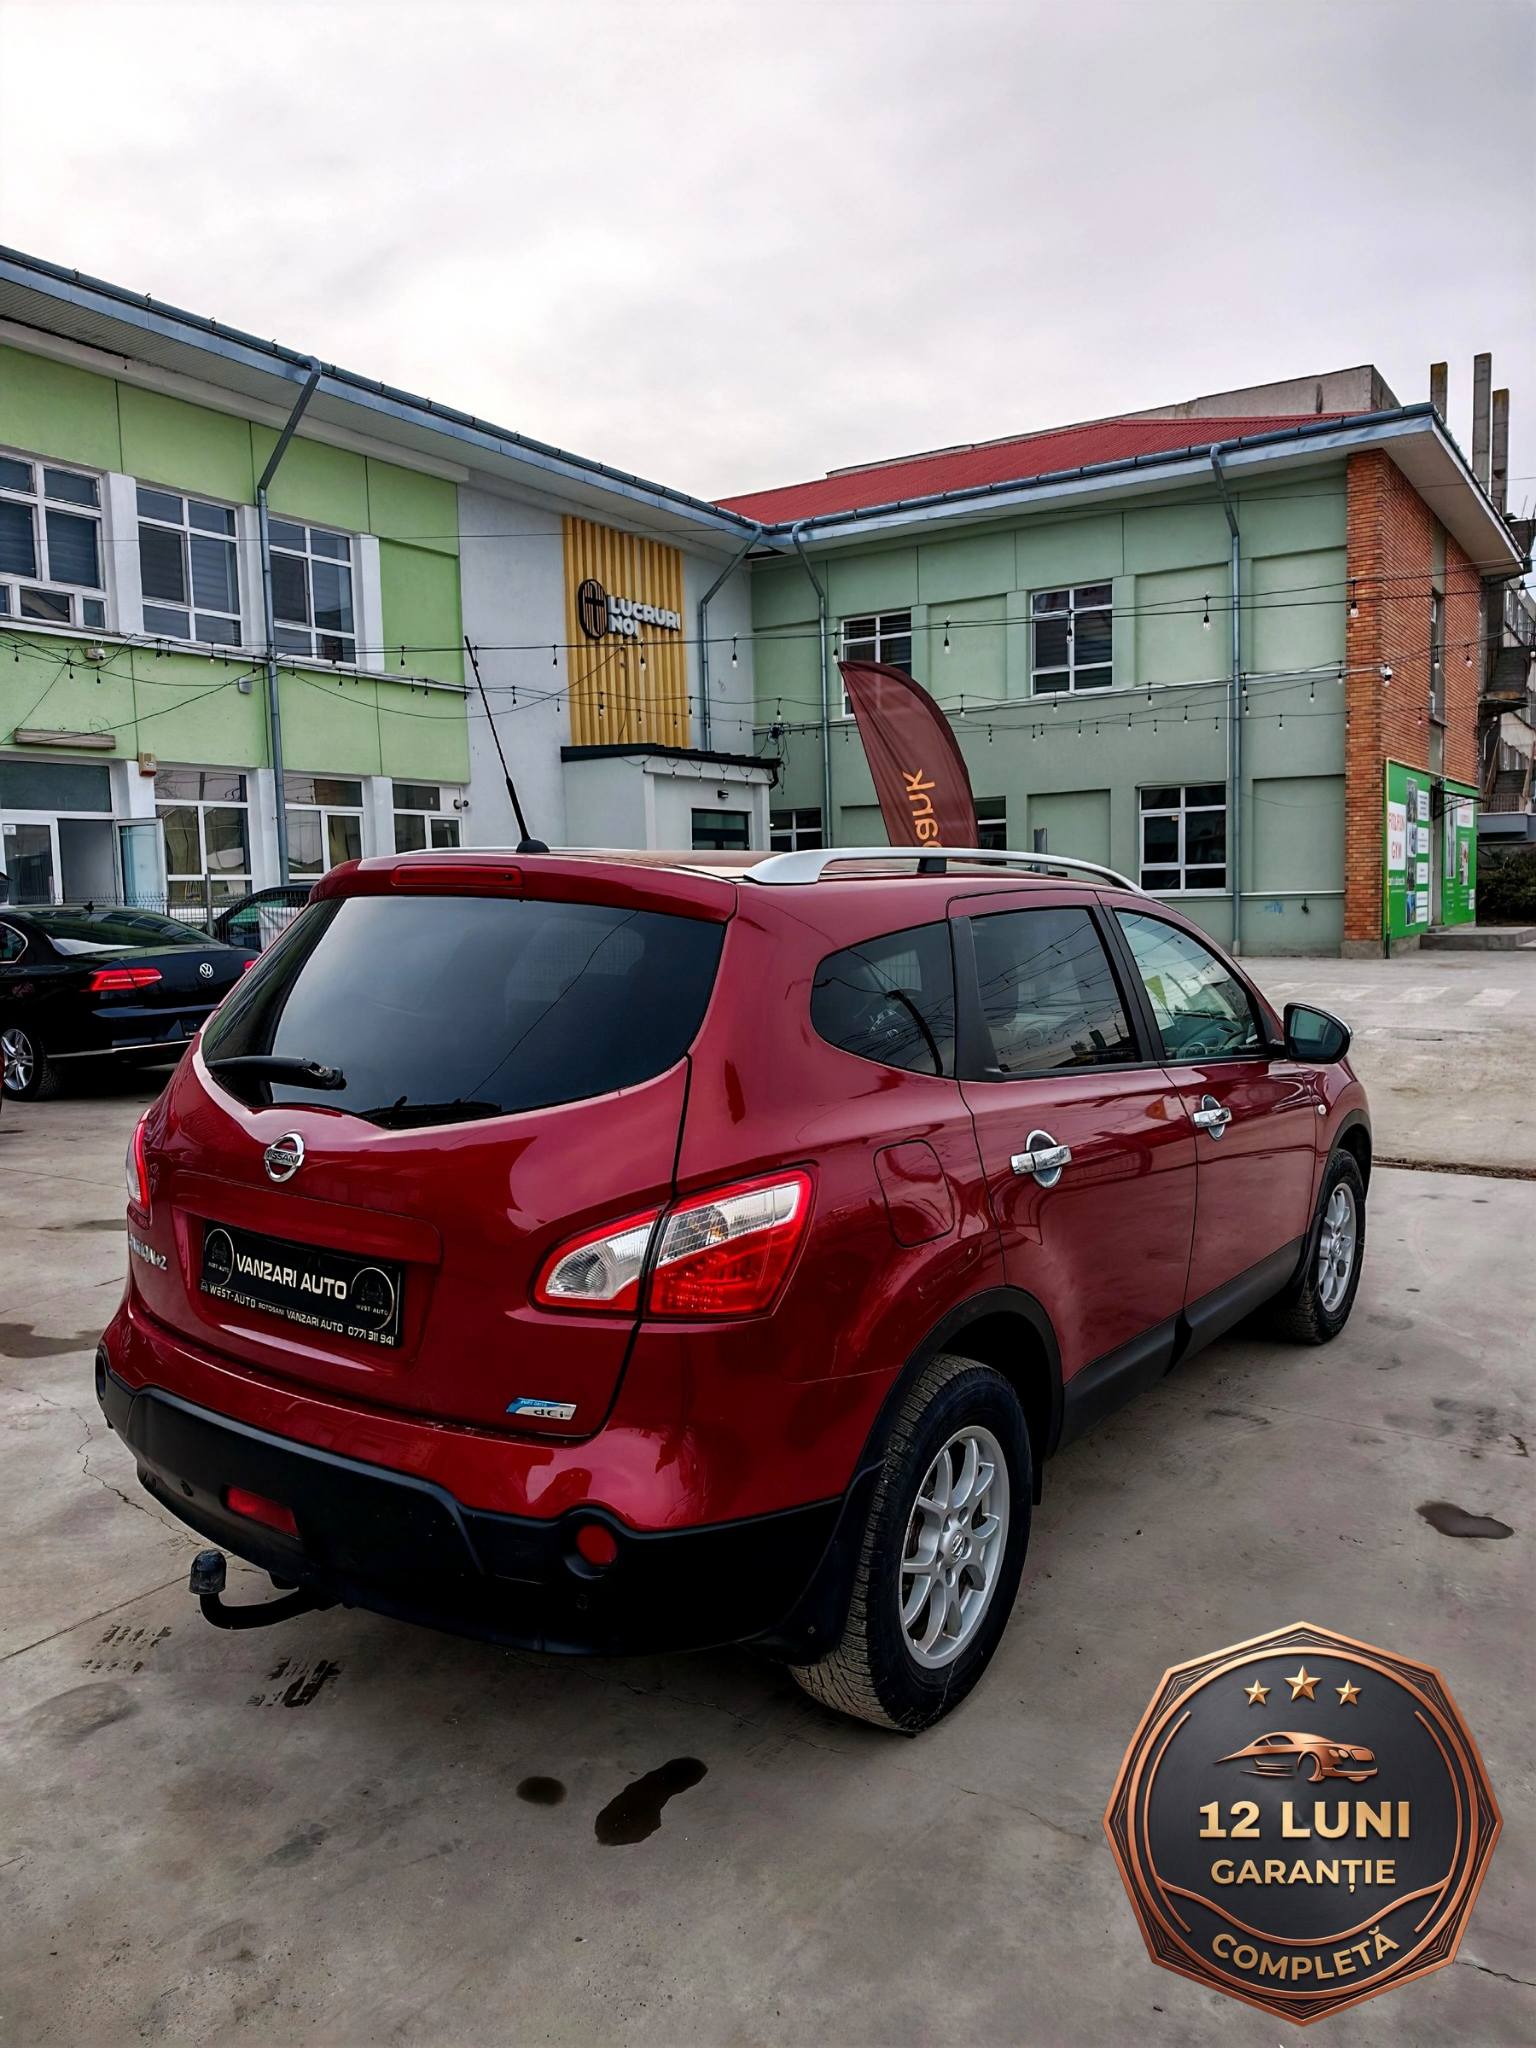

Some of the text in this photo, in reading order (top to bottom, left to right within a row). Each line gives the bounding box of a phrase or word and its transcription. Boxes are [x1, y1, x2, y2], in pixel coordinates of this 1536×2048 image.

[607, 595, 681, 631] LUCRURI
[607, 614, 640, 637] NOI
[236, 1253, 347, 1300] VANZARI AUTO
[209, 1284, 256, 1308] WEST-AUTO
[286, 1309, 319, 1327] VANZARI
[320, 1319, 343, 1332] AUTO
[347, 1326, 366, 1339] 0771
[368, 1331, 378, 1342] 311
[380, 1334, 394, 1345] 941
